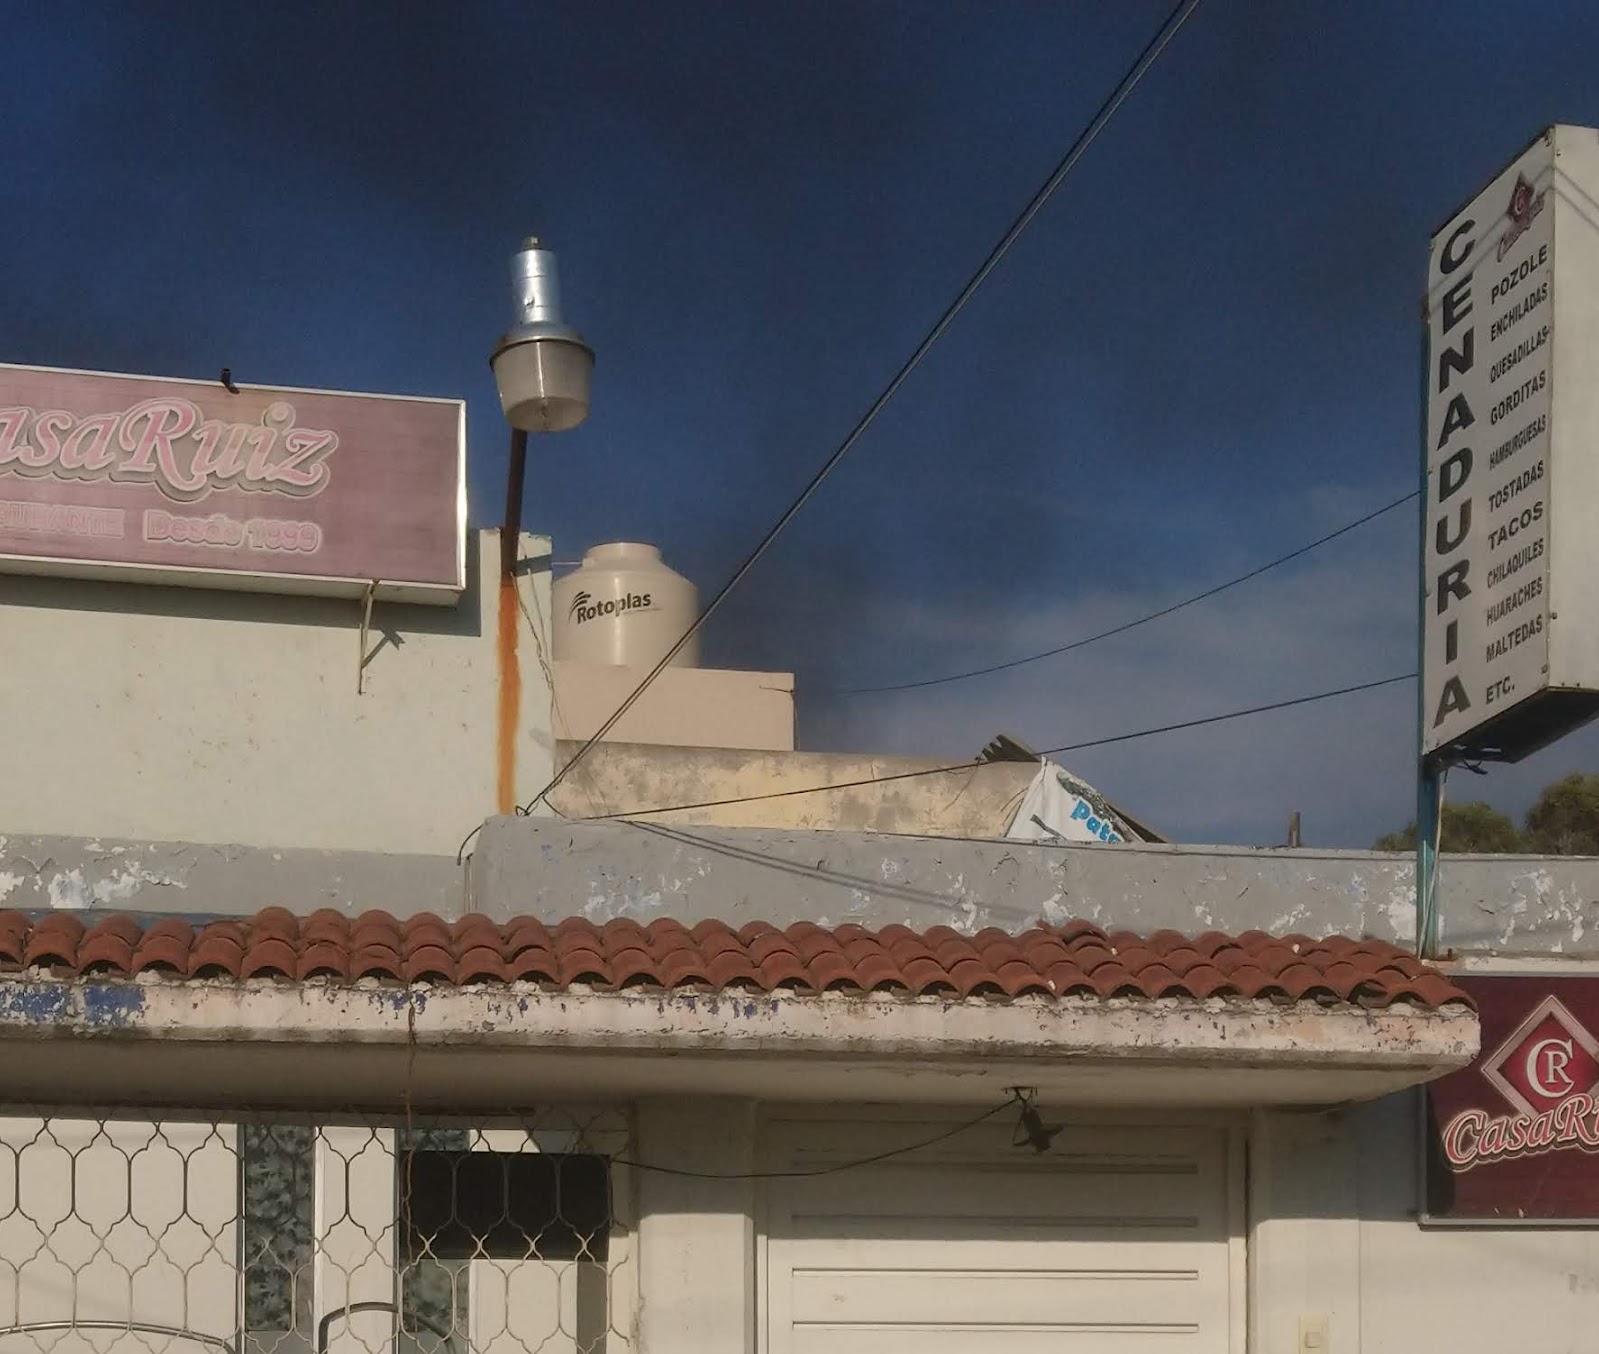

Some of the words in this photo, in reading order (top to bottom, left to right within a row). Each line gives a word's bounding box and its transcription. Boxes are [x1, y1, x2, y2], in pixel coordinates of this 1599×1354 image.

[1491, 244, 1548, 305] POZOLE
[1490, 282, 1549, 342] ENCHILADAS
[1490, 325, 1549, 384] QUESADILLAS
[1490, 369, 1547, 426] GORDITAS
[1489, 414, 1547, 471] HAMBURGUESAS
[1433, 219, 1476, 729] CENADURIA
[1488, 460, 1544, 513] TOSTADAS
[143, 510, 244, 546] Desde
[1487, 500, 1543, 551] TACOS
[1487, 537, 1544, 590] CHILAQUILES
[576, 592, 653, 624] Rotoplas
[1486, 576, 1543, 627] HUARACHES
[1486, 614, 1543, 663] MALTEDAS
[1485, 675, 1516, 705] ETC.
